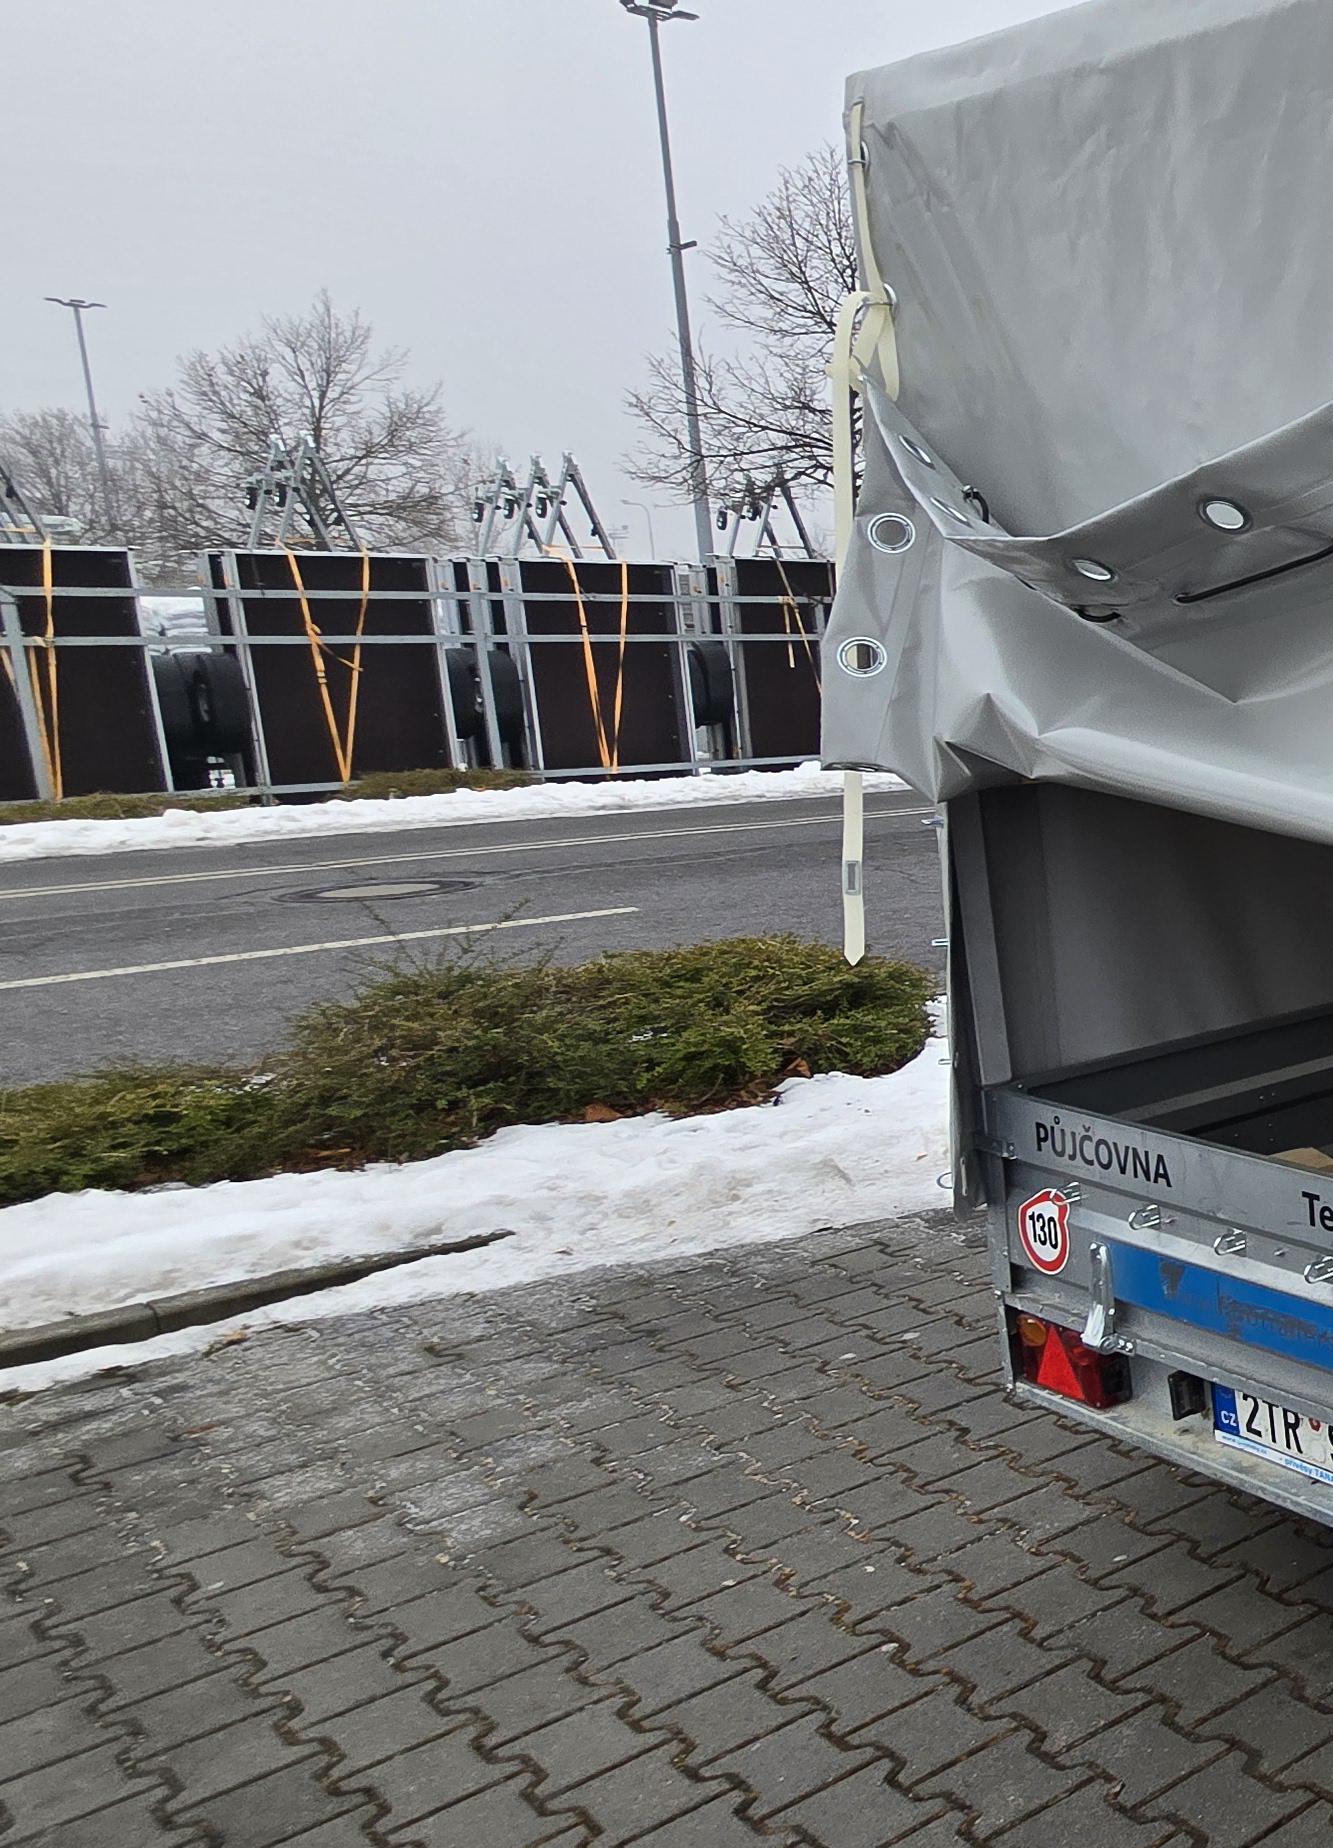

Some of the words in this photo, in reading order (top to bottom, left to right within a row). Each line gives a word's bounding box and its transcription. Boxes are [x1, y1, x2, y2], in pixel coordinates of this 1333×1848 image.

[1035, 1115, 1173, 1188] PŮJČOVNA
[1028, 1211, 1058, 1250] 130
[1220, 1410, 1237, 1427] CZ
[1243, 1394, 1304, 1454] 2TR
